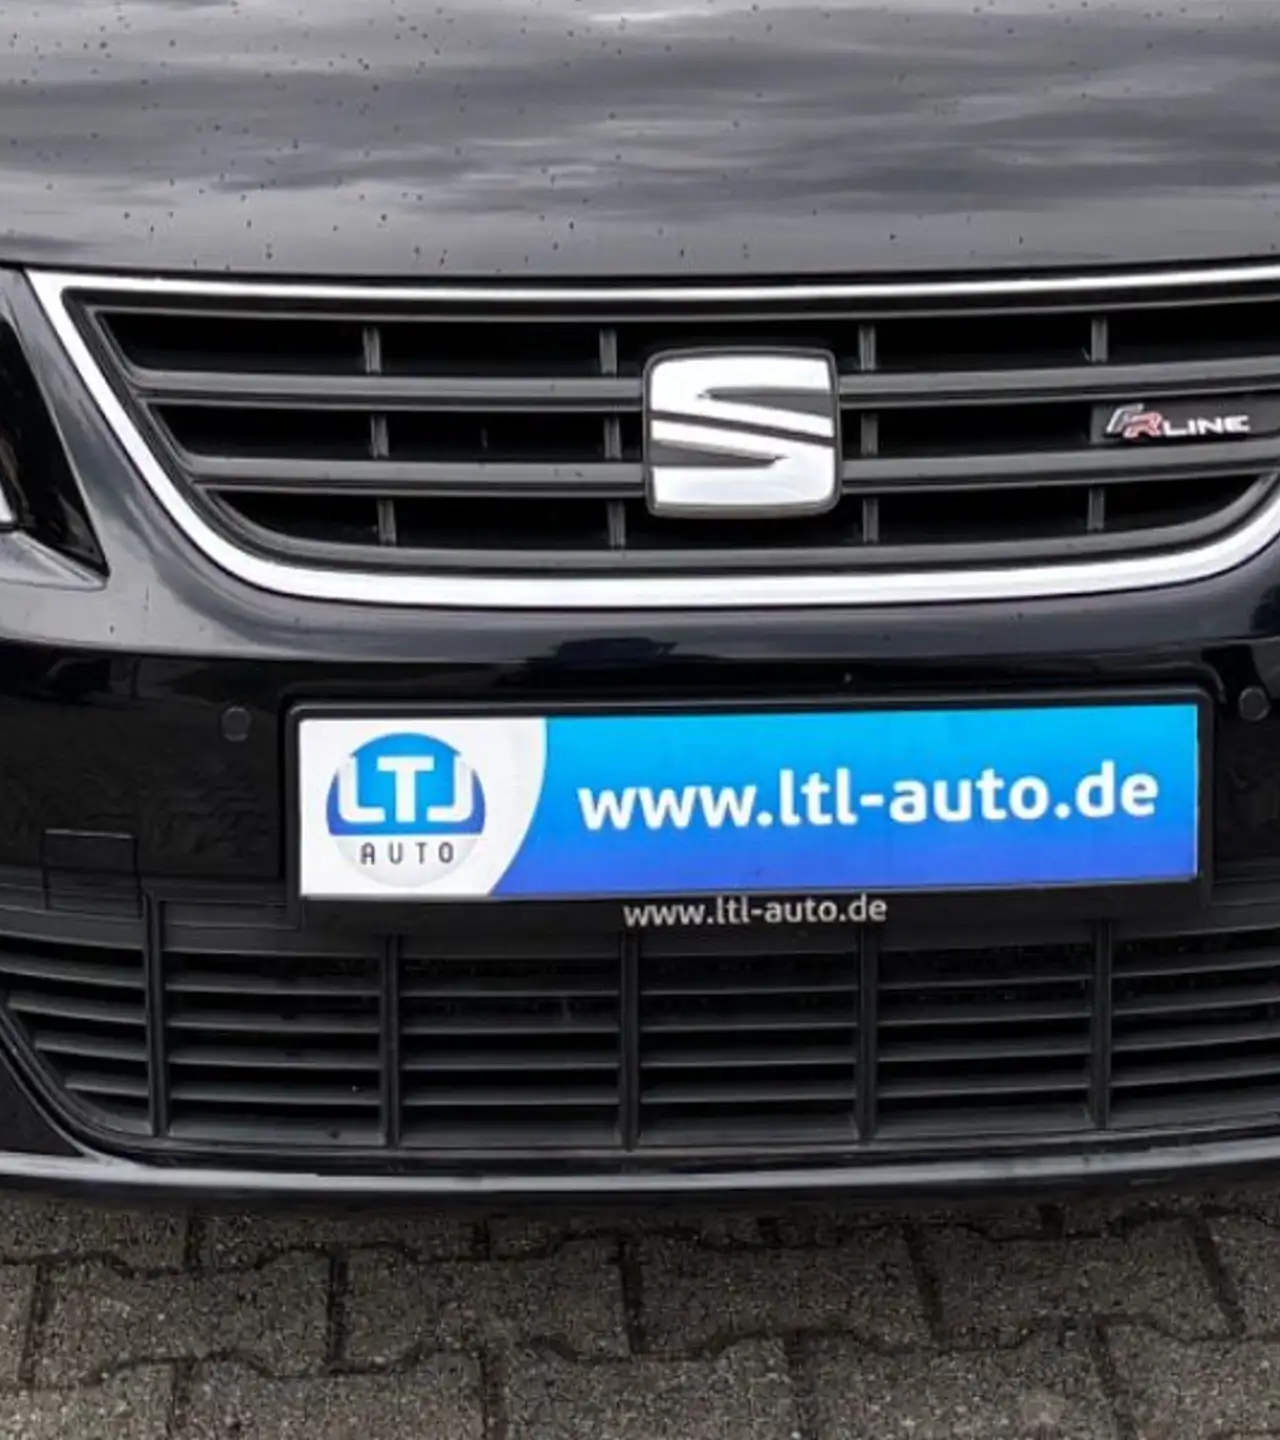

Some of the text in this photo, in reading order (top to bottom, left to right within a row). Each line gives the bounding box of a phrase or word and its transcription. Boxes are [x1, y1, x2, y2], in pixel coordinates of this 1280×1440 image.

[577, 760, 1160, 831] www.ltl-auto.de
[359, 842, 455, 865] AUTO
[623, 893, 888, 927] www.ltl-auto.de
